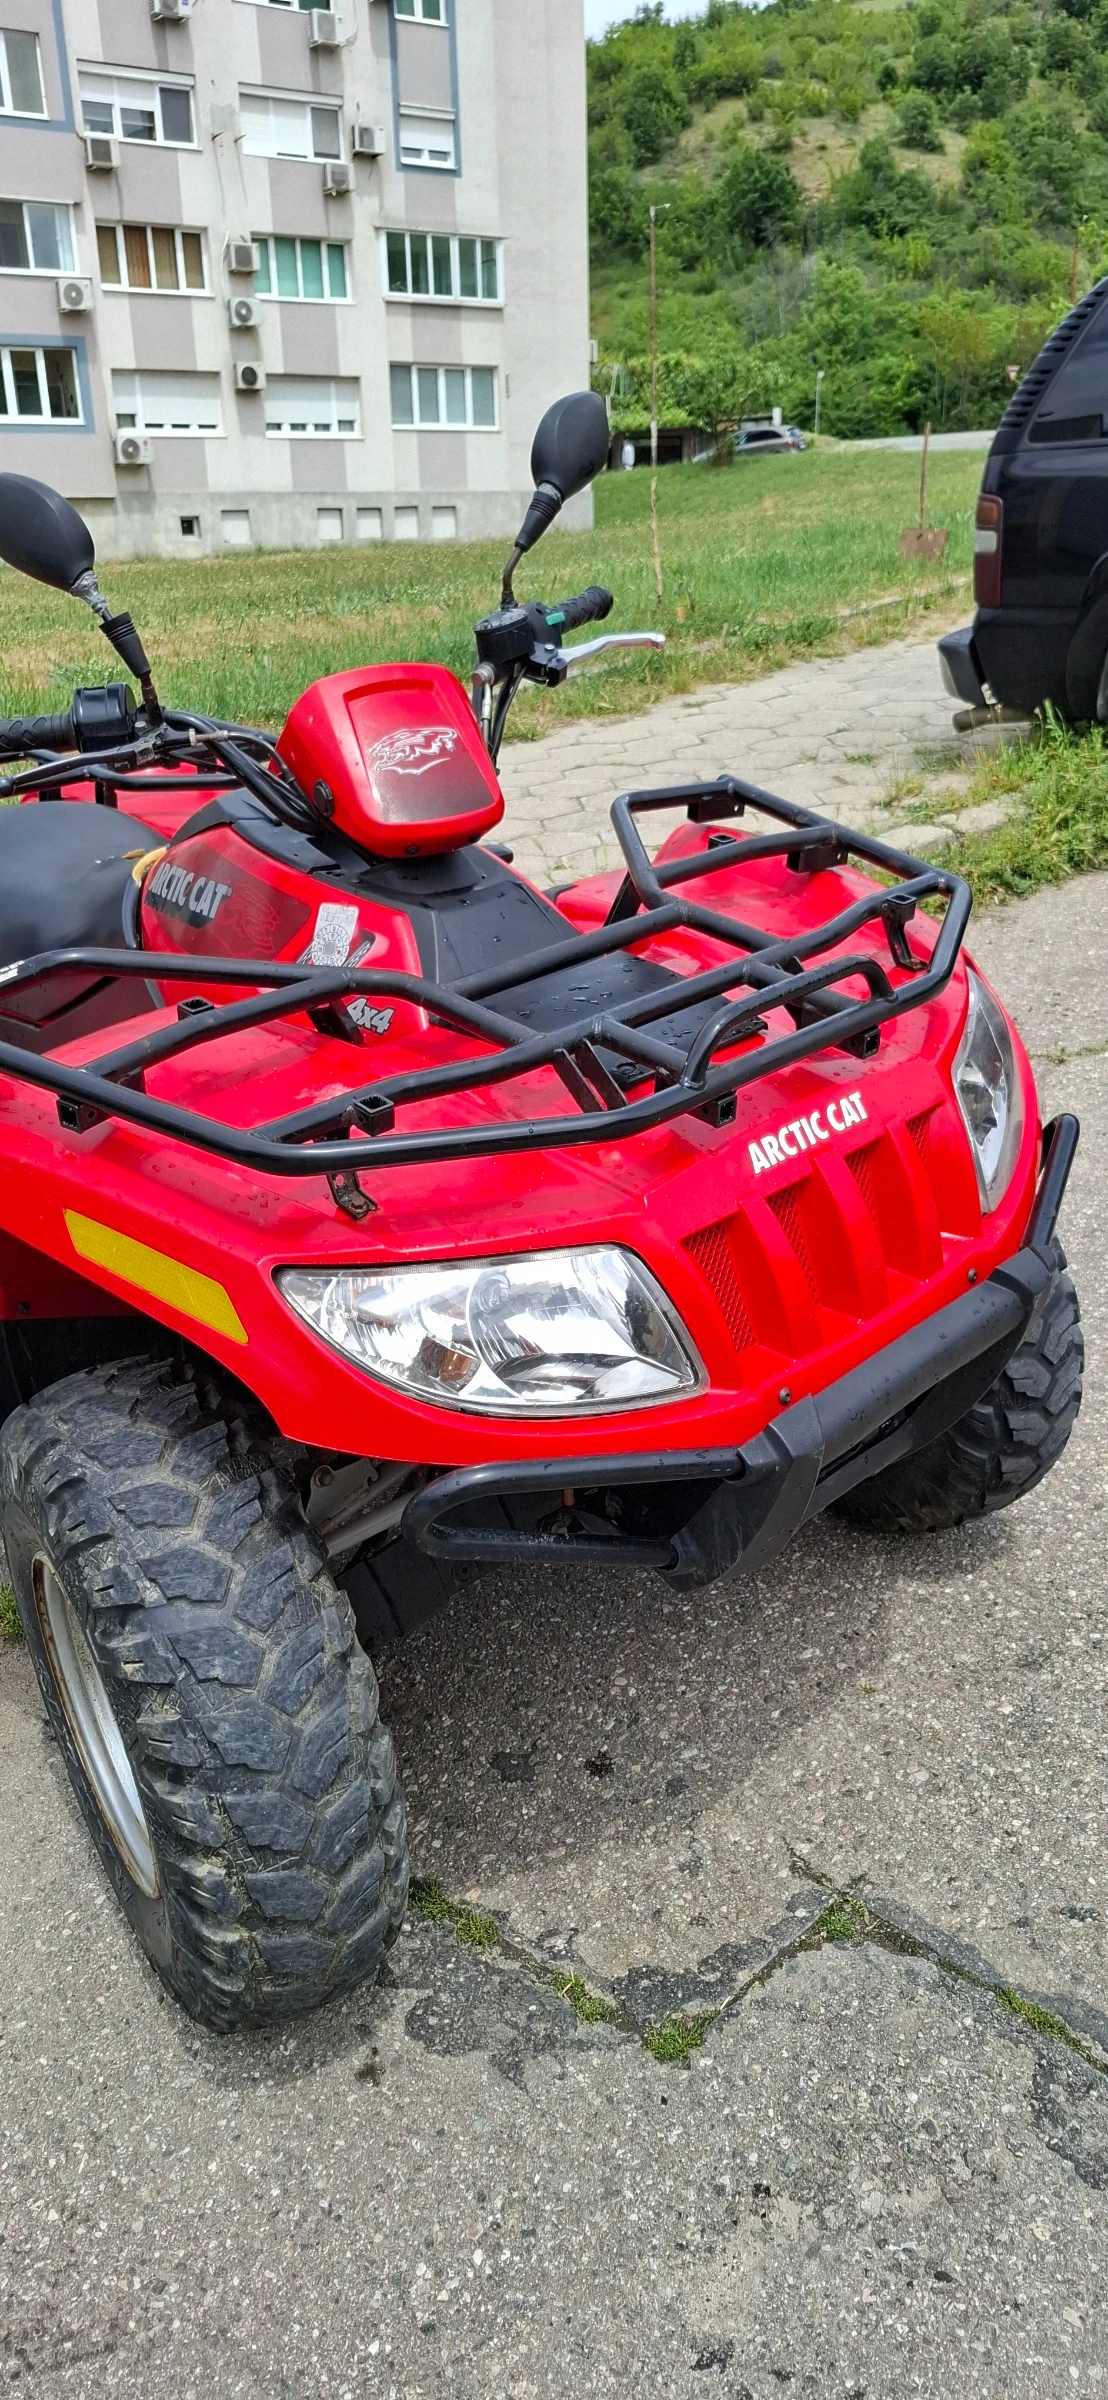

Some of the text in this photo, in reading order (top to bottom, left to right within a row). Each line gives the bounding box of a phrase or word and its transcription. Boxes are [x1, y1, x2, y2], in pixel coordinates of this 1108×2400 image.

[149, 862, 195, 906] ARCTIC
[346, 997, 394, 1034] 4x4
[748, 1091, 868, 1175] ARCTIC CAT
